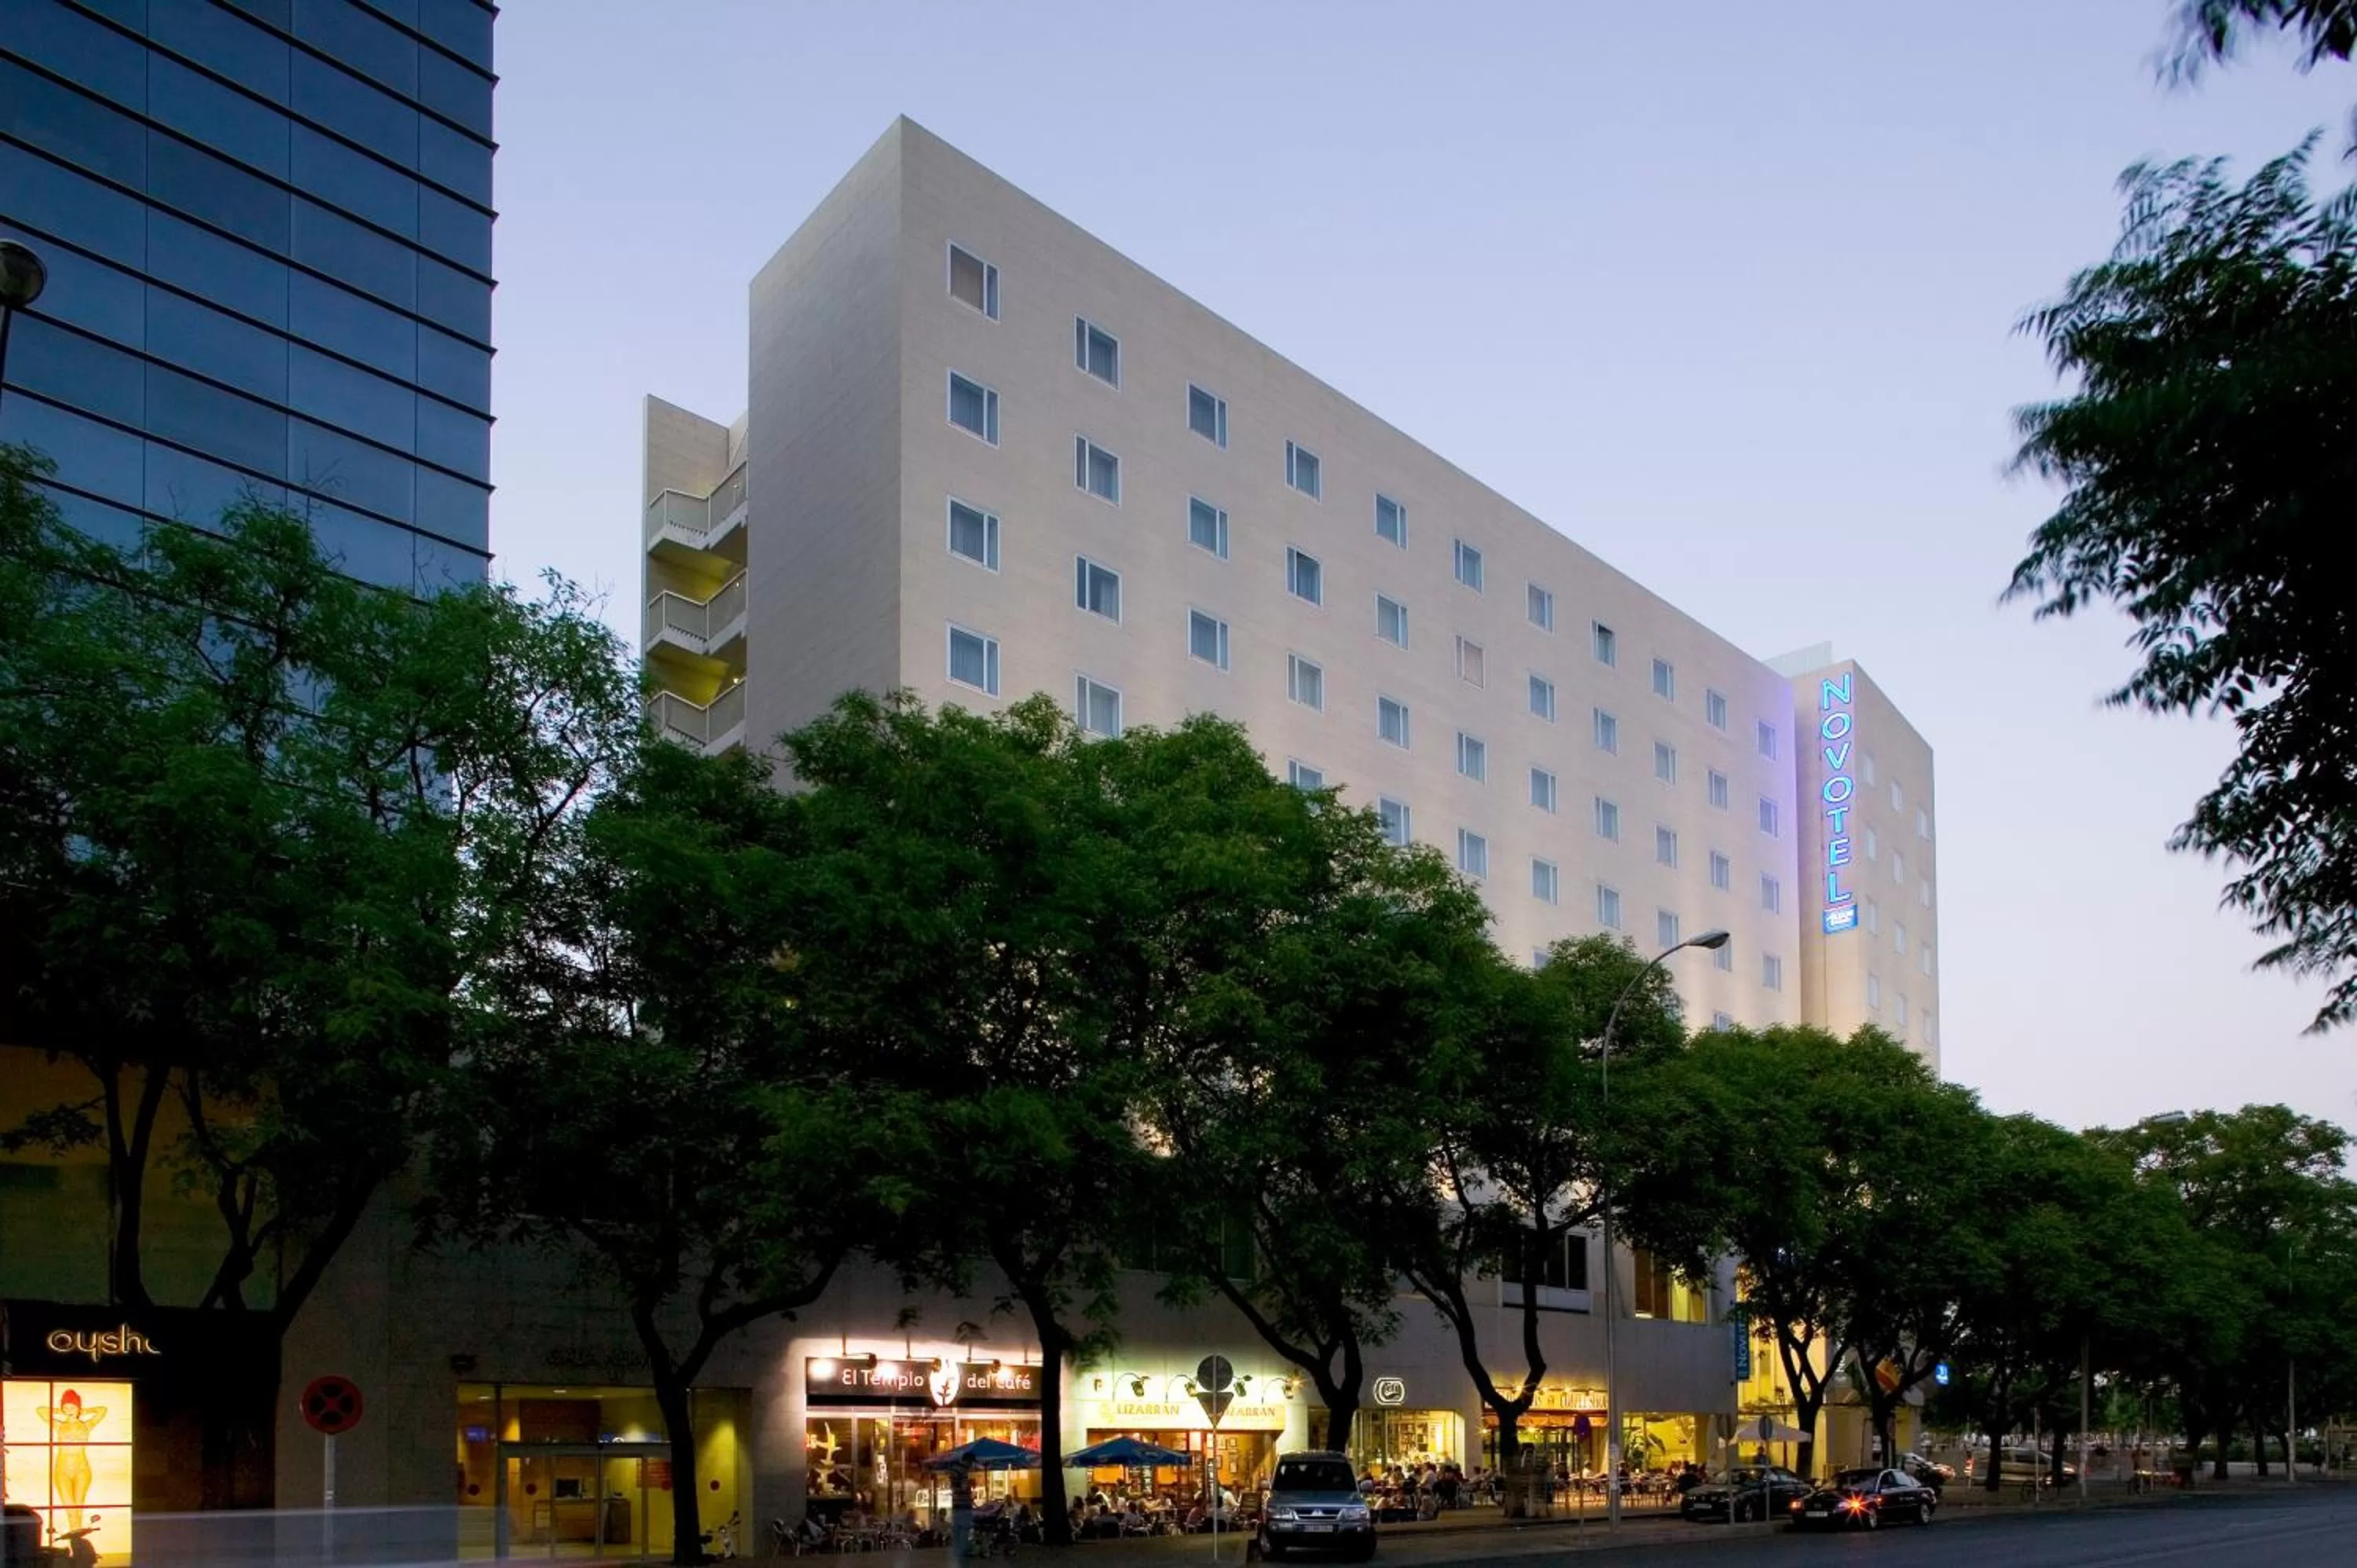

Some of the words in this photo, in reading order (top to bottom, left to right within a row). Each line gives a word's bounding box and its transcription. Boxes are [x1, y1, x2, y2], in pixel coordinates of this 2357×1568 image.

[1822, 672, 1853, 903] NOVOTEL
[841, 1368, 857, 1385] El
[860, 1369, 925, 1390] Templo
[967, 1373, 991, 1388] del
[1116, 1403, 1179, 1415] LIZARRAN
